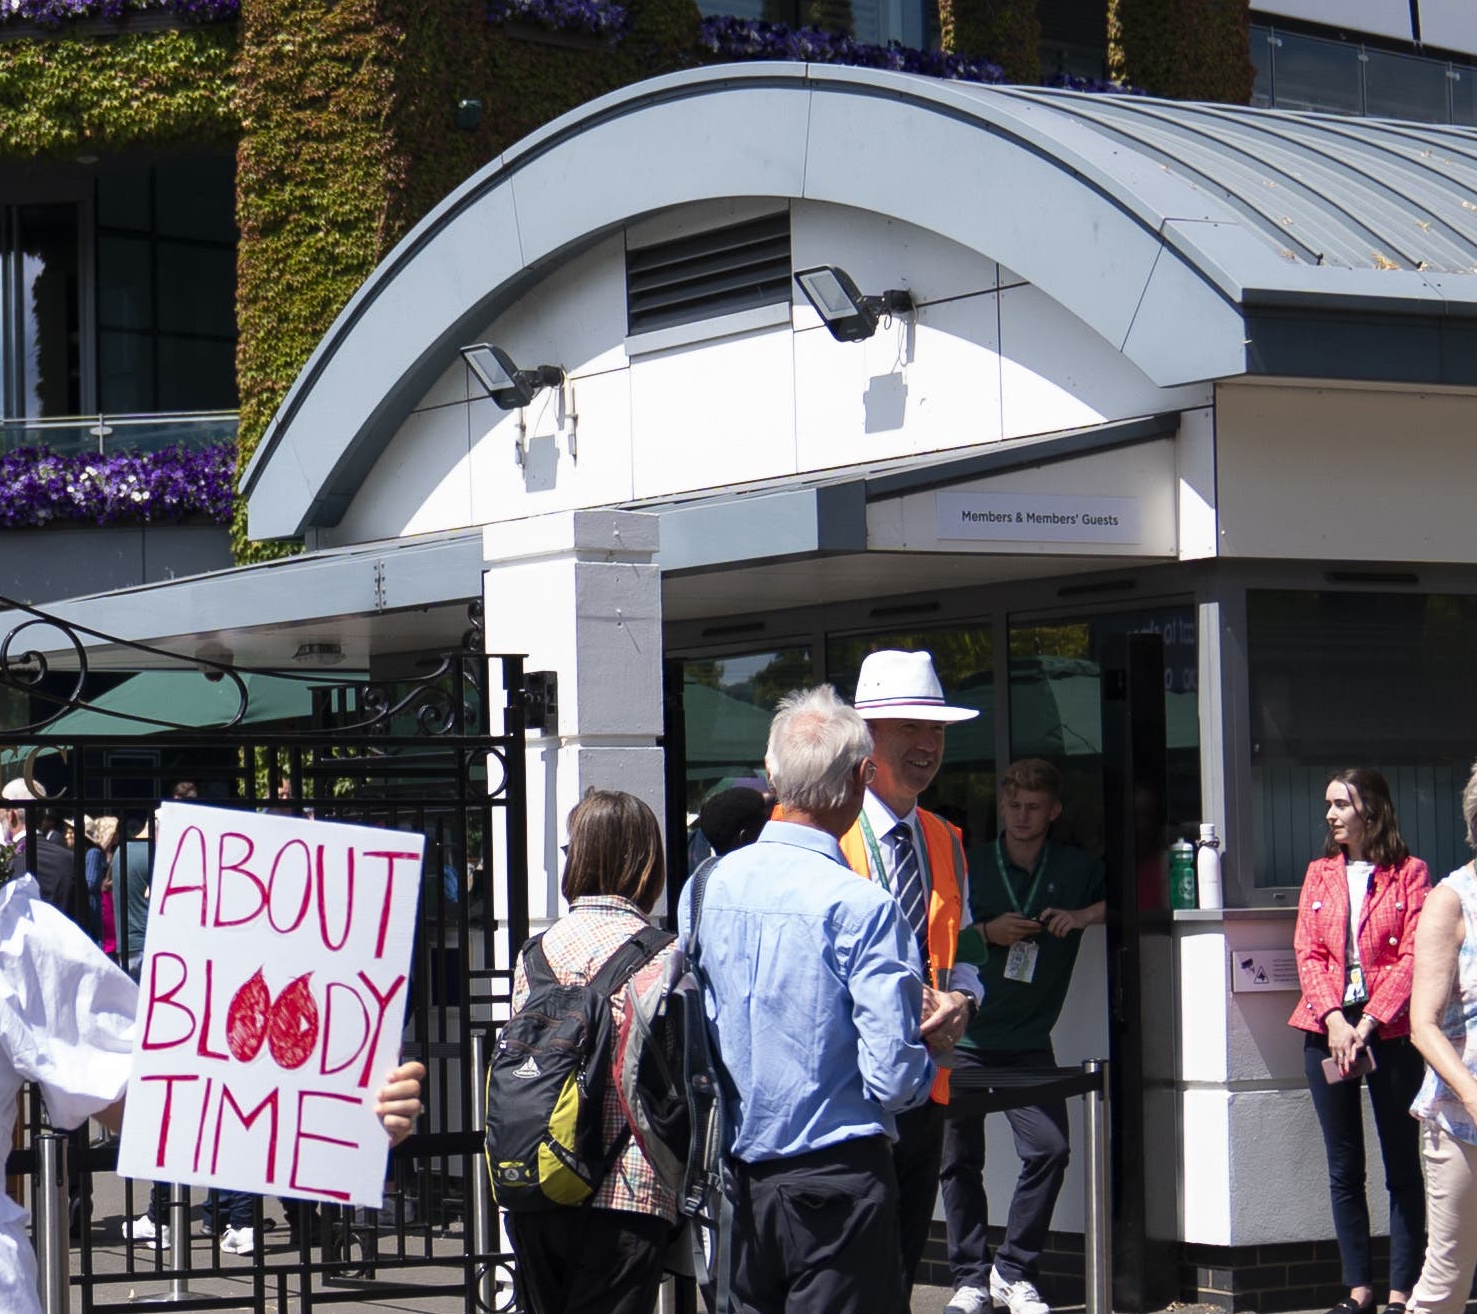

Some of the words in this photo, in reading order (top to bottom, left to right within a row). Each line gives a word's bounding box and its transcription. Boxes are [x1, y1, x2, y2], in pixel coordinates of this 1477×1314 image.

[961, 510, 1013, 523] Members
[1015, 512, 1024, 523] &
[1026, 512, 1079, 525] Members'
[1082, 513, 1120, 526] Guests
[159, 825, 421, 960] ABOUT
[141, 951, 406, 1088] BLOODY
[140, 1074, 364, 1202] TIME
